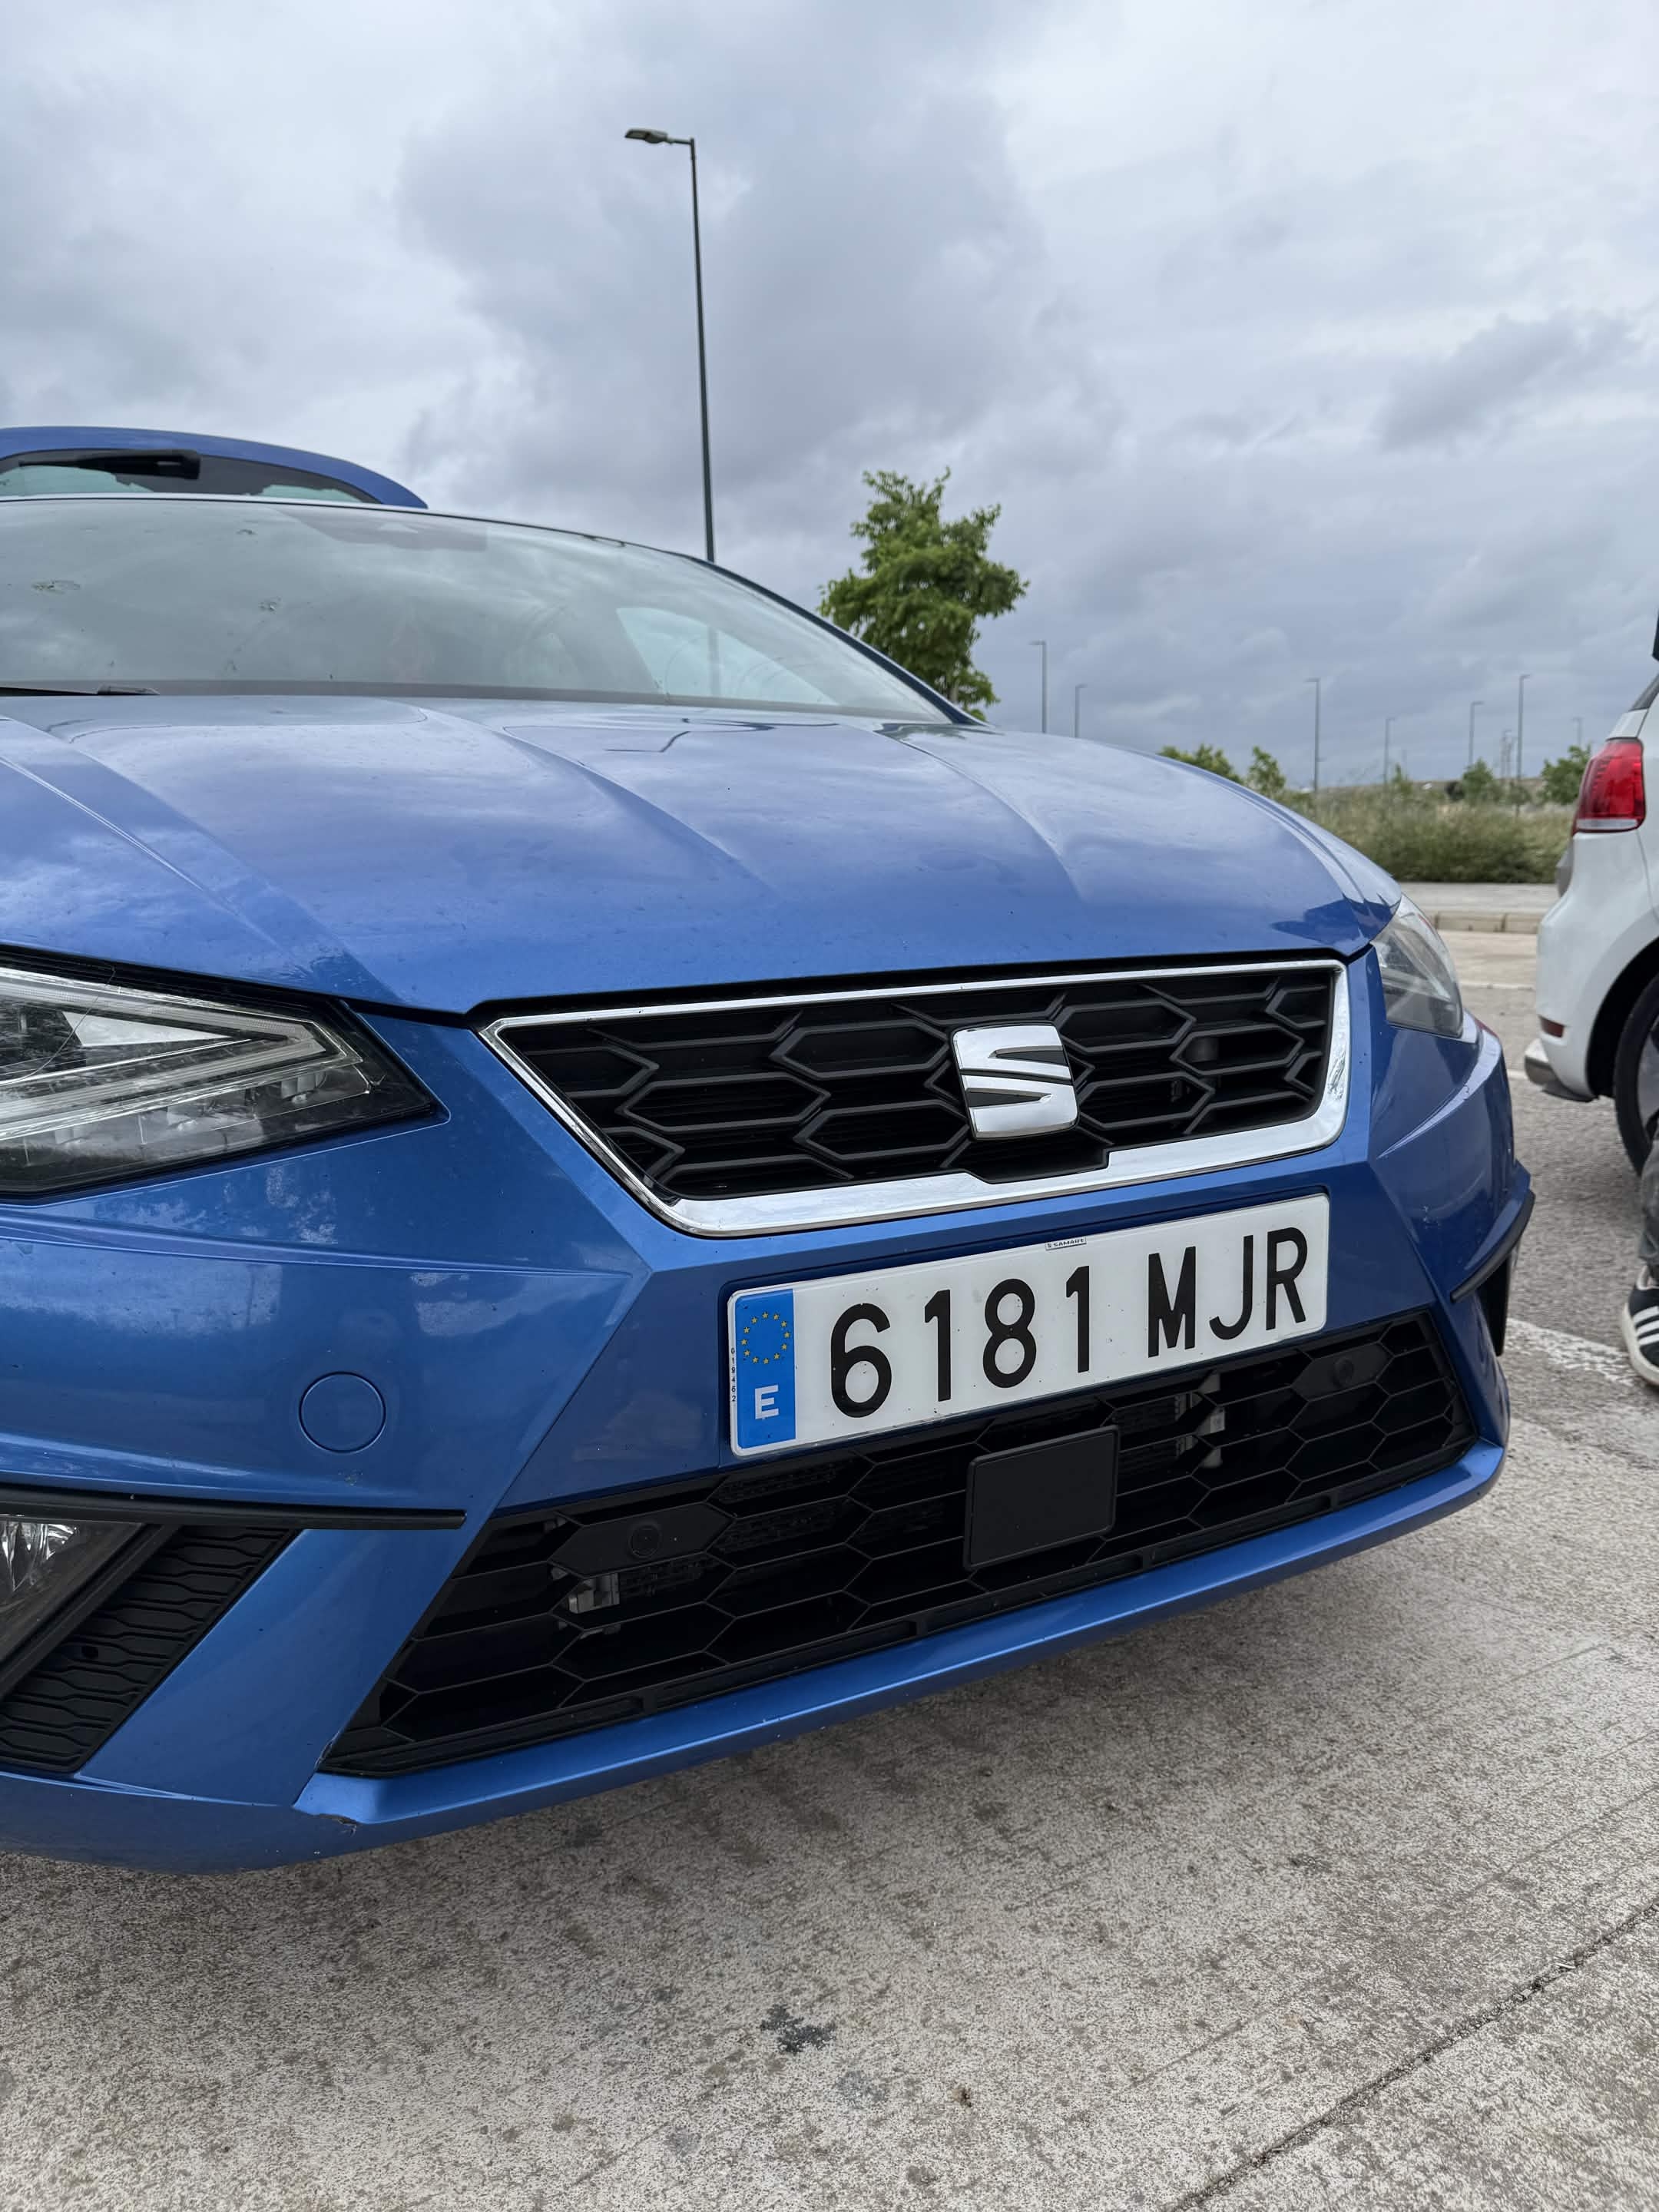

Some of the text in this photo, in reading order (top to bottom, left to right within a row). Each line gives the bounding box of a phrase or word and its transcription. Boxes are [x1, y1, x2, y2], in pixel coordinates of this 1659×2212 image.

[831, 1227, 1308, 1419] 6181 MJR
[755, 1385, 779, 1419] E
